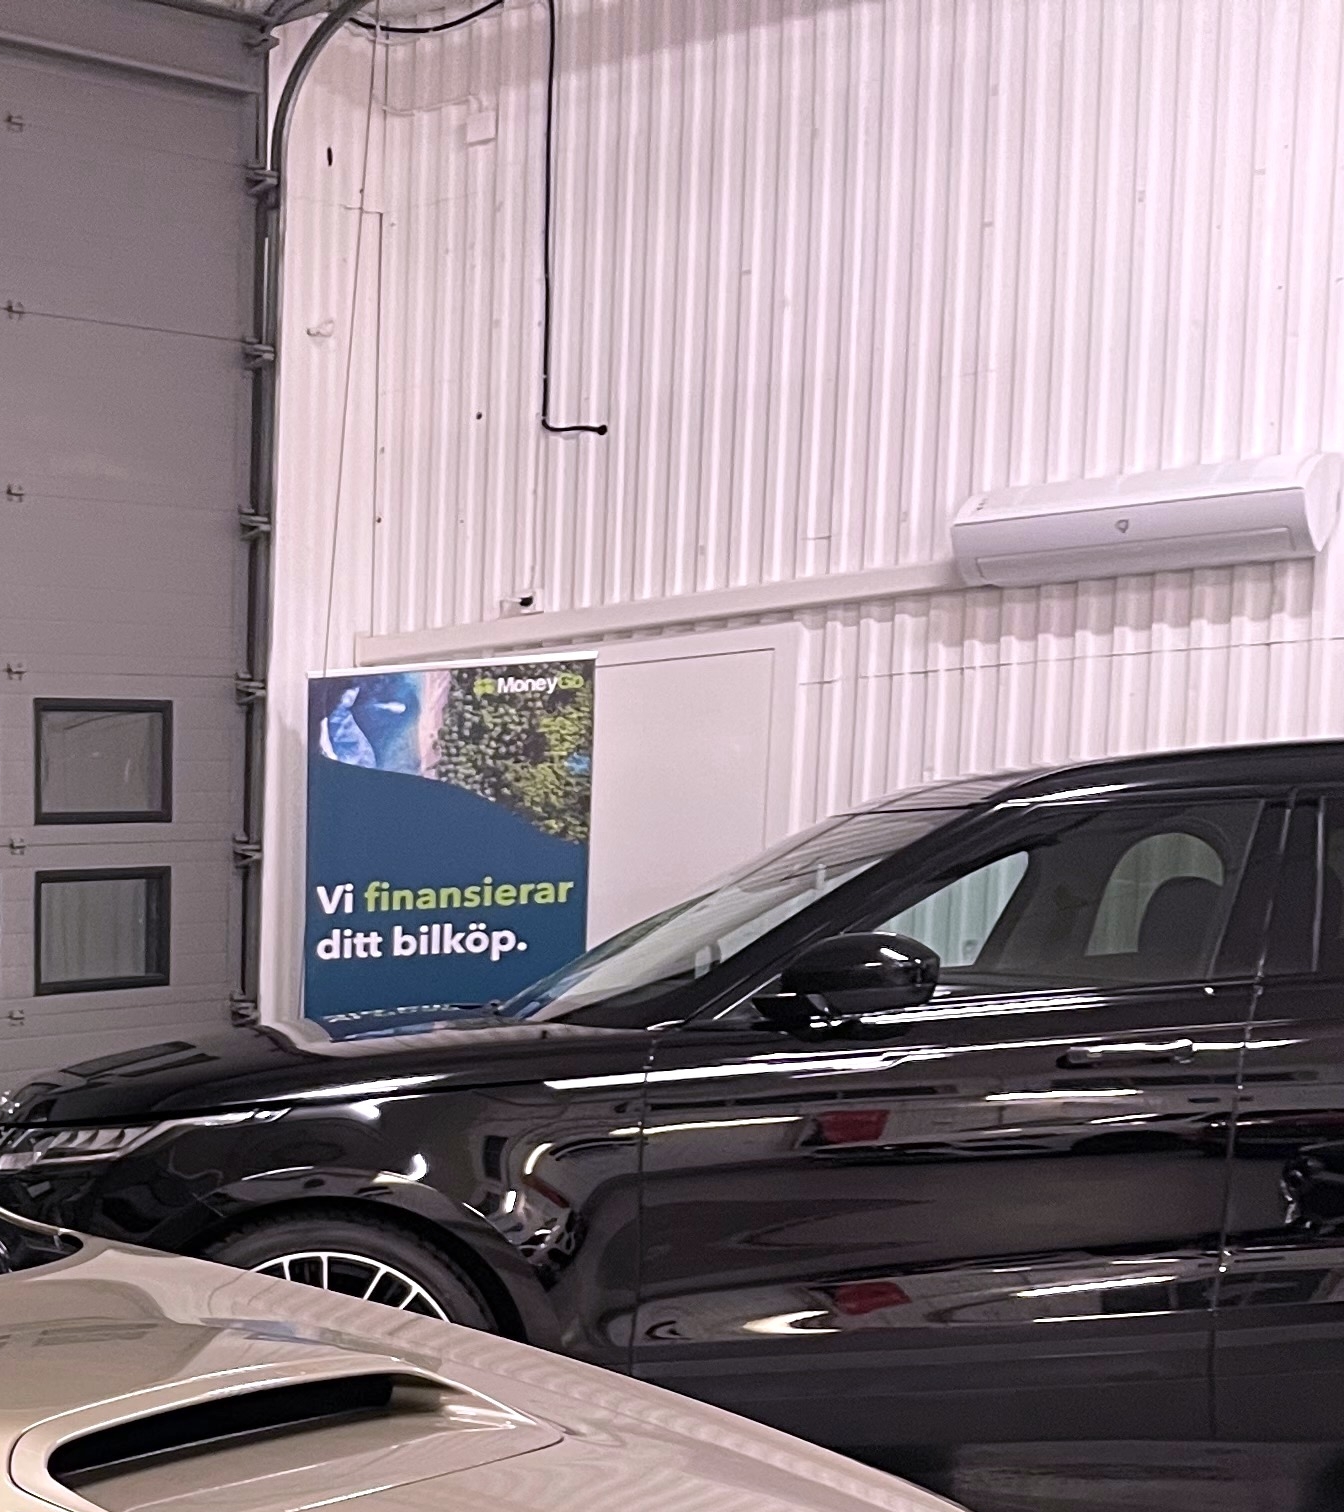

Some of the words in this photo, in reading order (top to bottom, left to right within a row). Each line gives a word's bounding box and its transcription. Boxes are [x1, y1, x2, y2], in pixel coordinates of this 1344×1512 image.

[316, 883, 355, 915] Vi
[365, 876, 575, 912] finansierar
[316, 928, 383, 960] ditt
[393, 922, 528, 962] bilköp.
